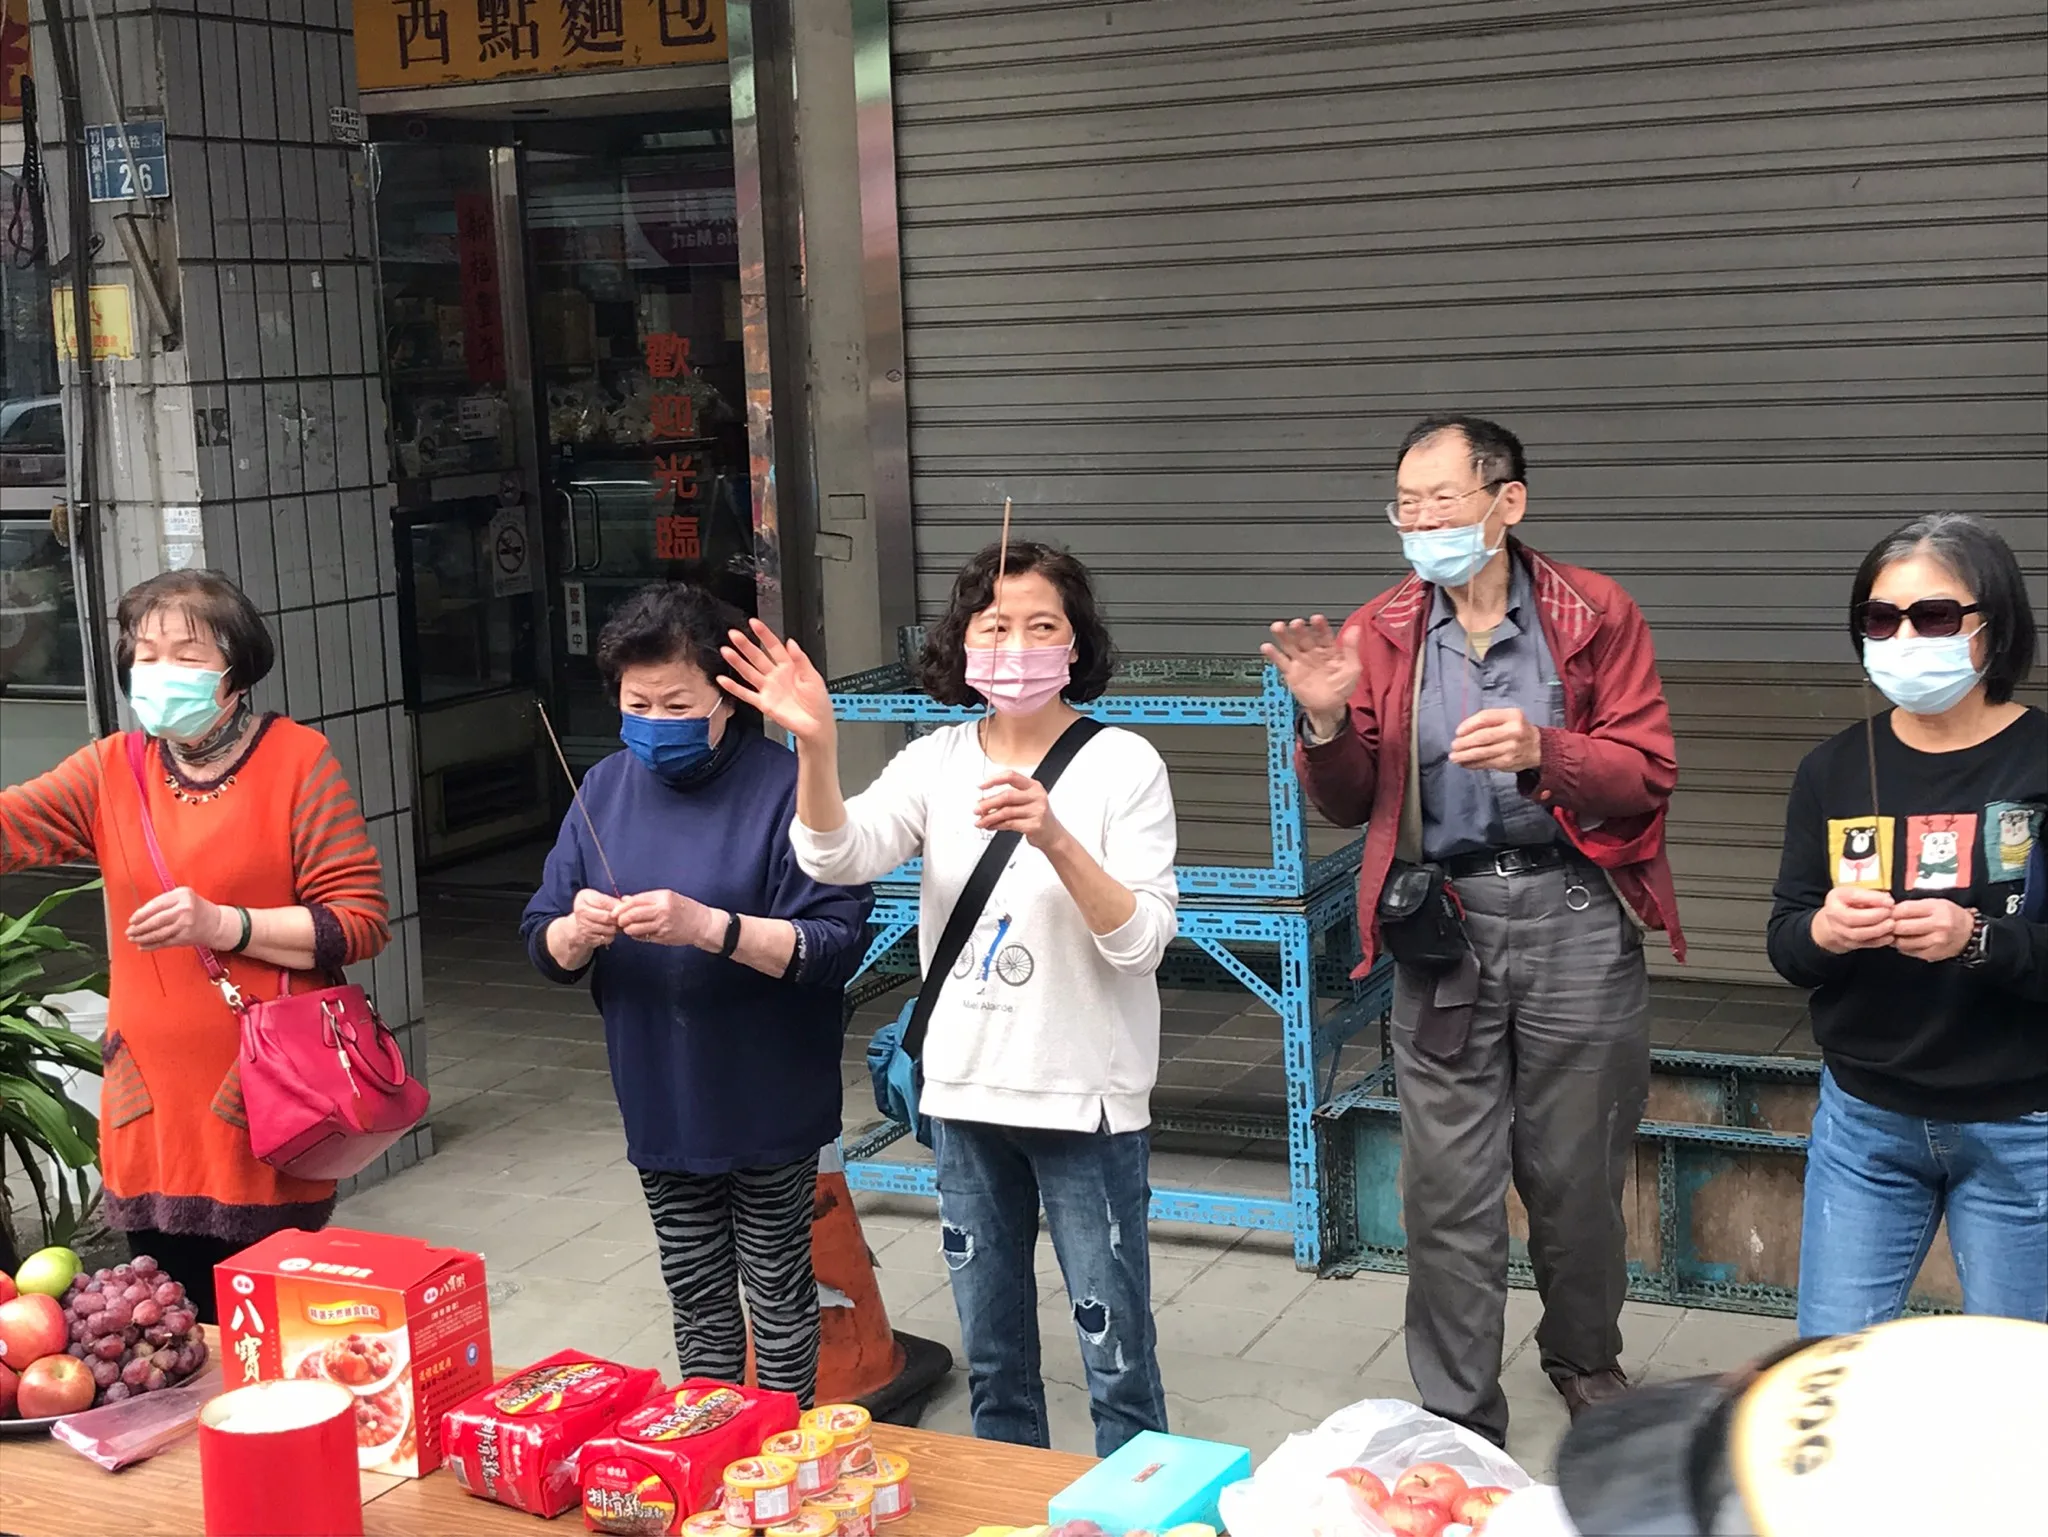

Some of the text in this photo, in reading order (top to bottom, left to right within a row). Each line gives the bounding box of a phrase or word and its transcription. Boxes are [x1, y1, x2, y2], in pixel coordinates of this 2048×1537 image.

[393, 0, 717, 69] 西點麵包
[119, 163, 153, 194] 26
[644, 332, 700, 559] 歡迎光臨
